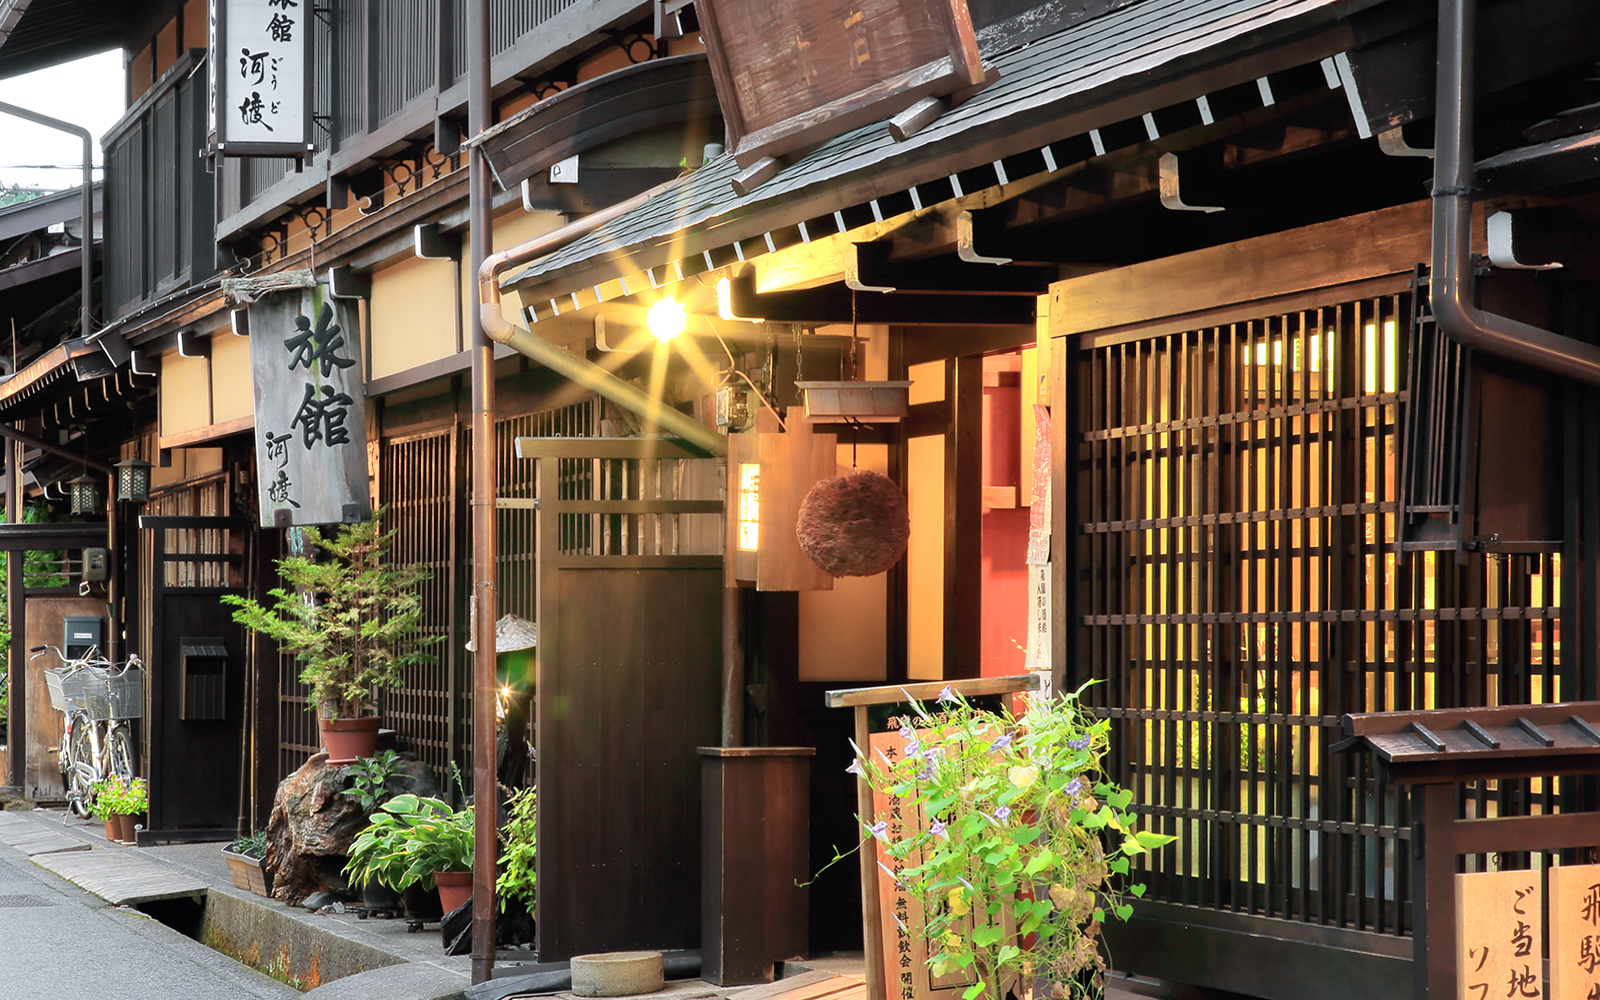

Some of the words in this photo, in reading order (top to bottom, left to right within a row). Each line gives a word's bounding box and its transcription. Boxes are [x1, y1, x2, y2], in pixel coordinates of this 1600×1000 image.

[271, 57, 283, 114] ごうど
[284, 302, 356, 450] 旅館
[1507, 886, 1540, 998] ご当地
